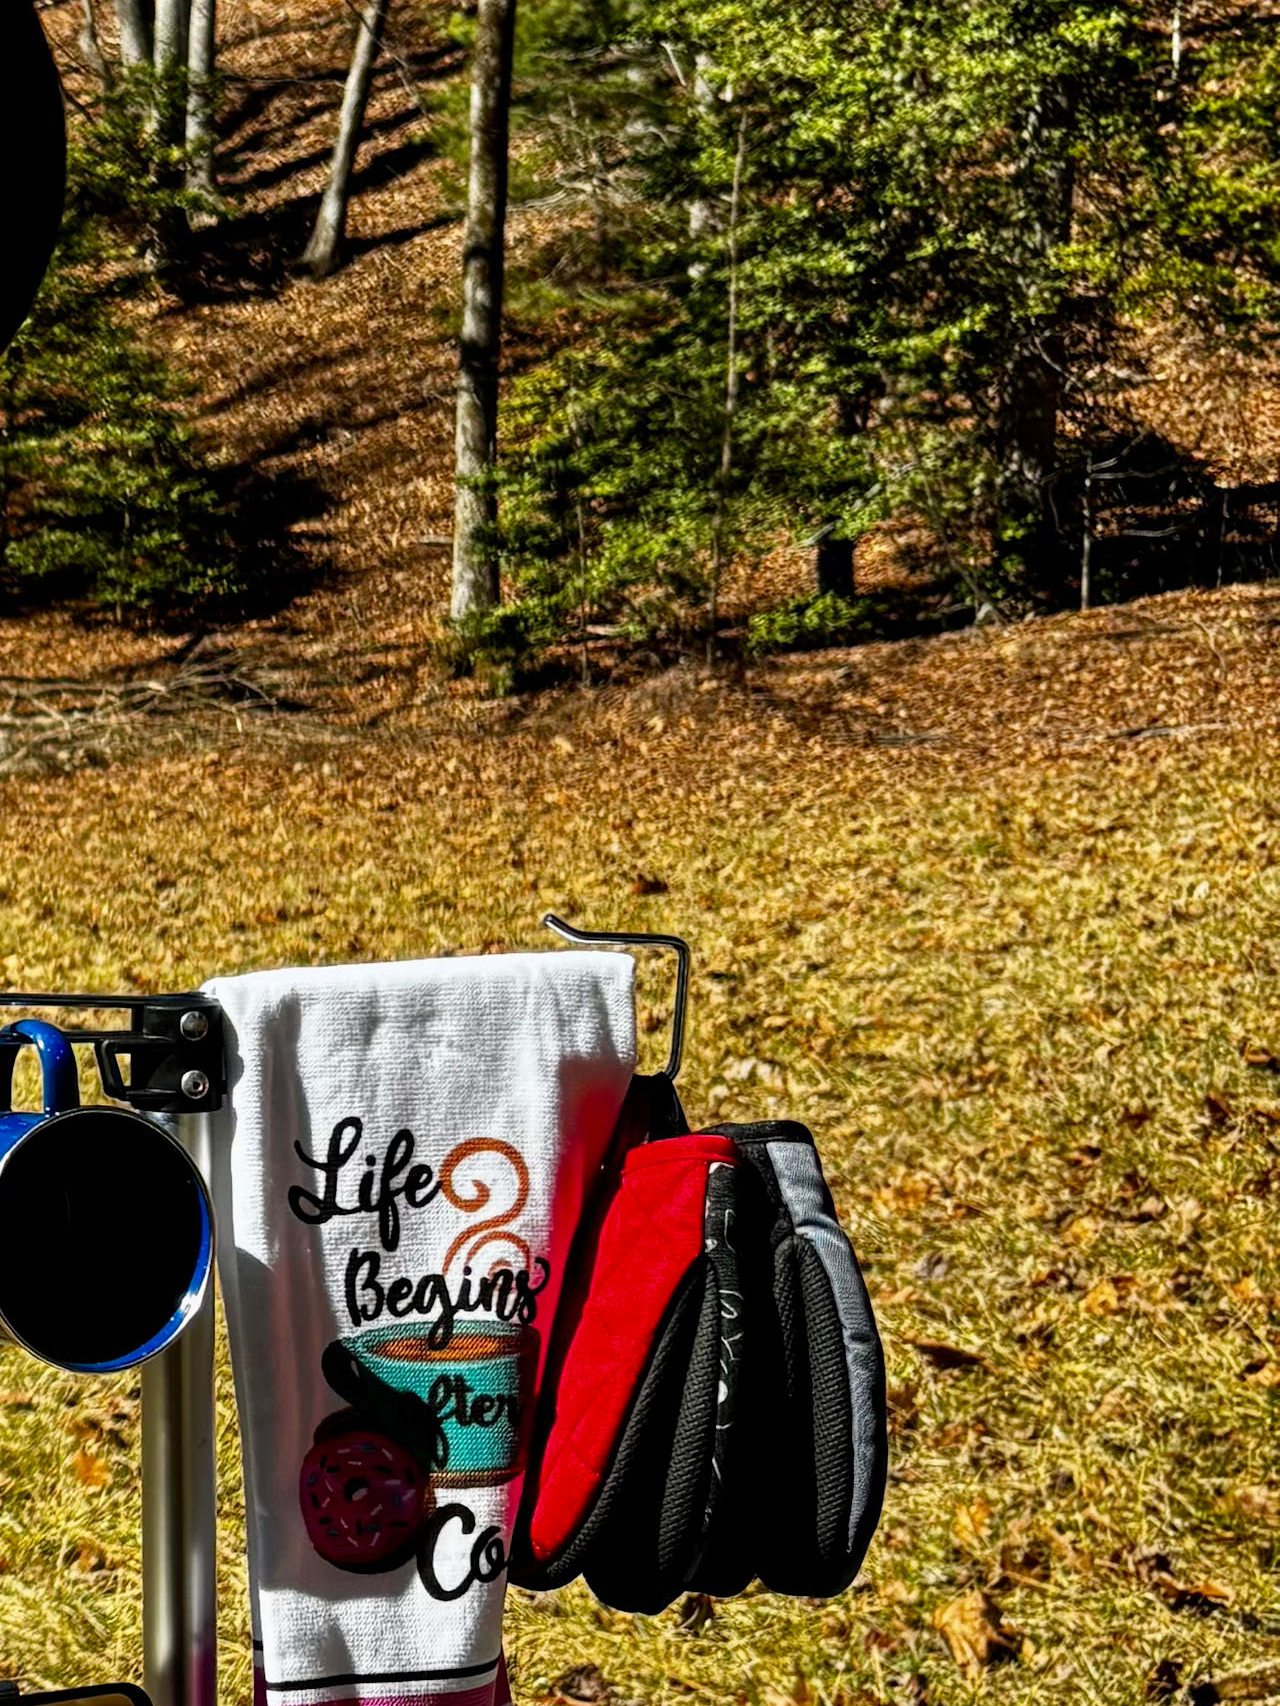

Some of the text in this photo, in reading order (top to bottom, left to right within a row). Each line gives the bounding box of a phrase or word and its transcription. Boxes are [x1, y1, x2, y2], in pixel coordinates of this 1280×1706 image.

[288, 1116, 440, 1252] Life
[345, 1247, 551, 1352] Begins
[412, 1373, 524, 1471] fter
